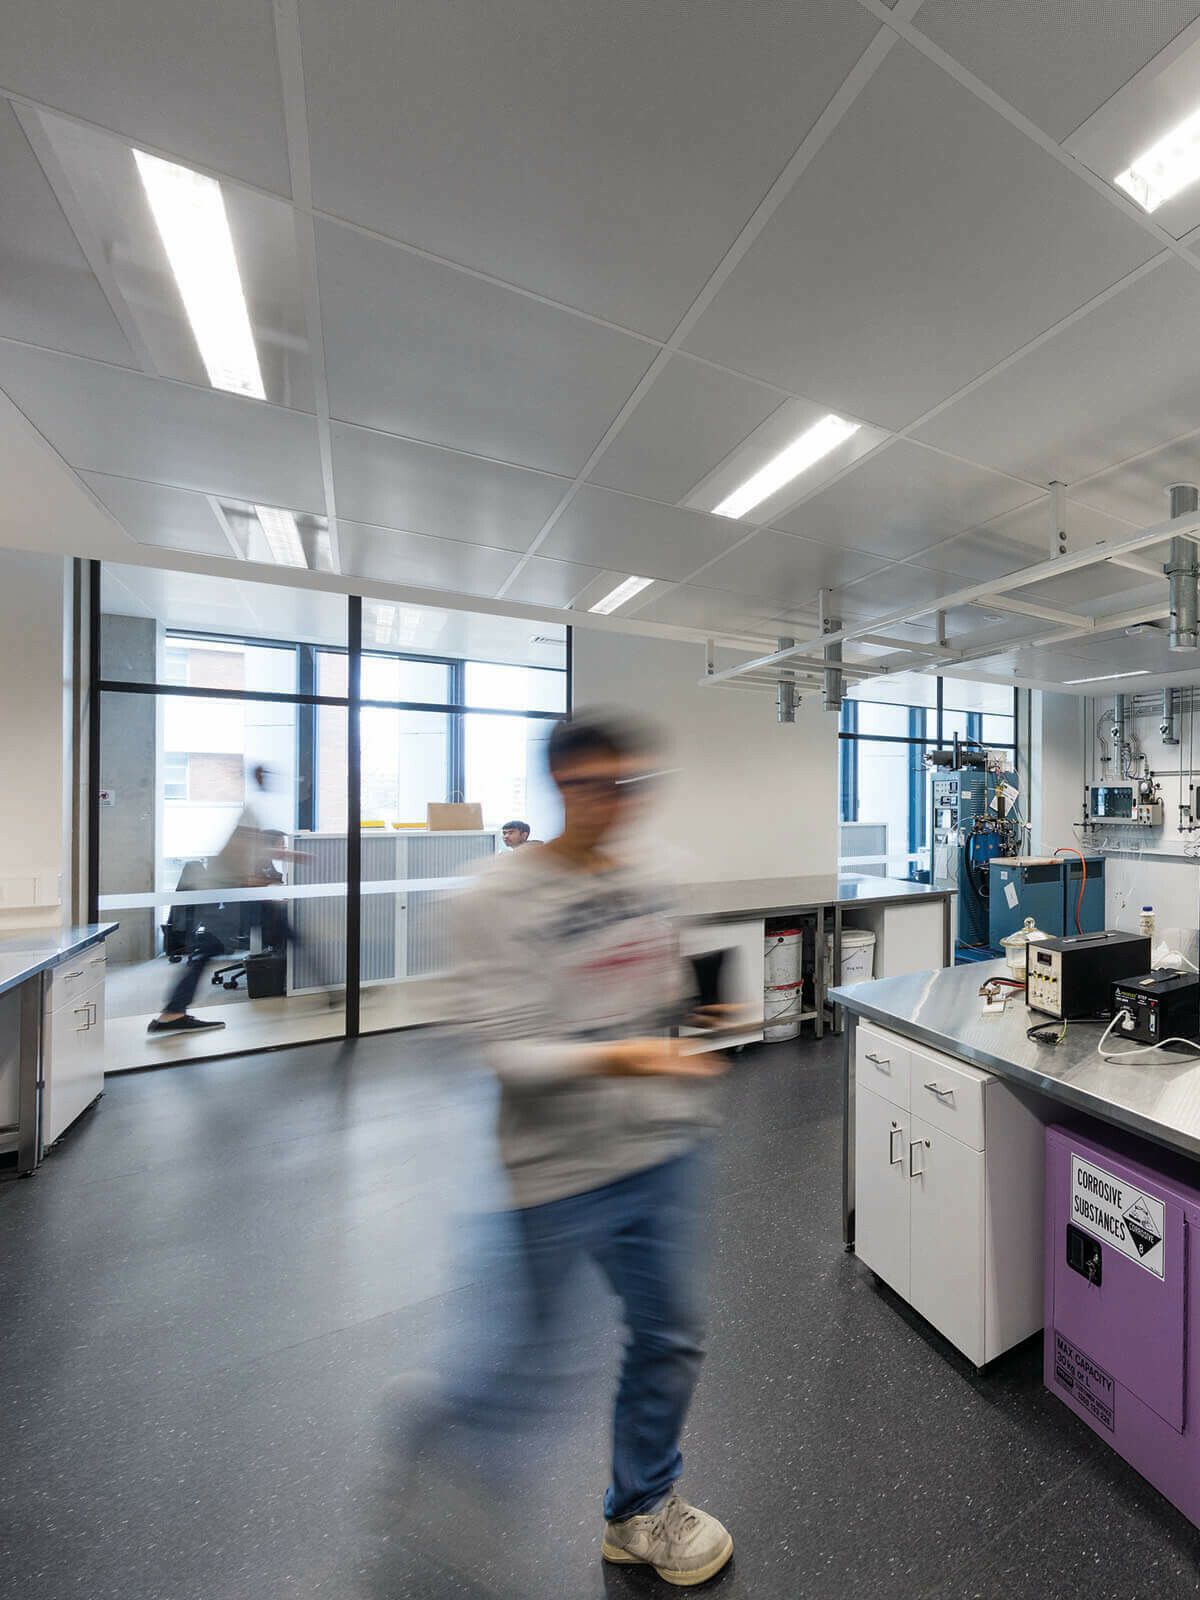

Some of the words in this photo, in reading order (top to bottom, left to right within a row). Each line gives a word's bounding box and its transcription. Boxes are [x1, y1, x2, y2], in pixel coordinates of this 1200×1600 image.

[1077, 1168, 1122, 1210] CORROSIVE
[1074, 1195, 1126, 1241] SUBSTANCES
[1129, 1222, 1154, 1243] CORROSIVE
[1138, 1243, 1144, 1254] 8
[1057, 1338, 1073, 1358] MAX
[1075, 1353, 1112, 1392] CAPACITY
[1077, 1371, 1084, 1382] or
[1086, 1376, 1090, 1387] L
